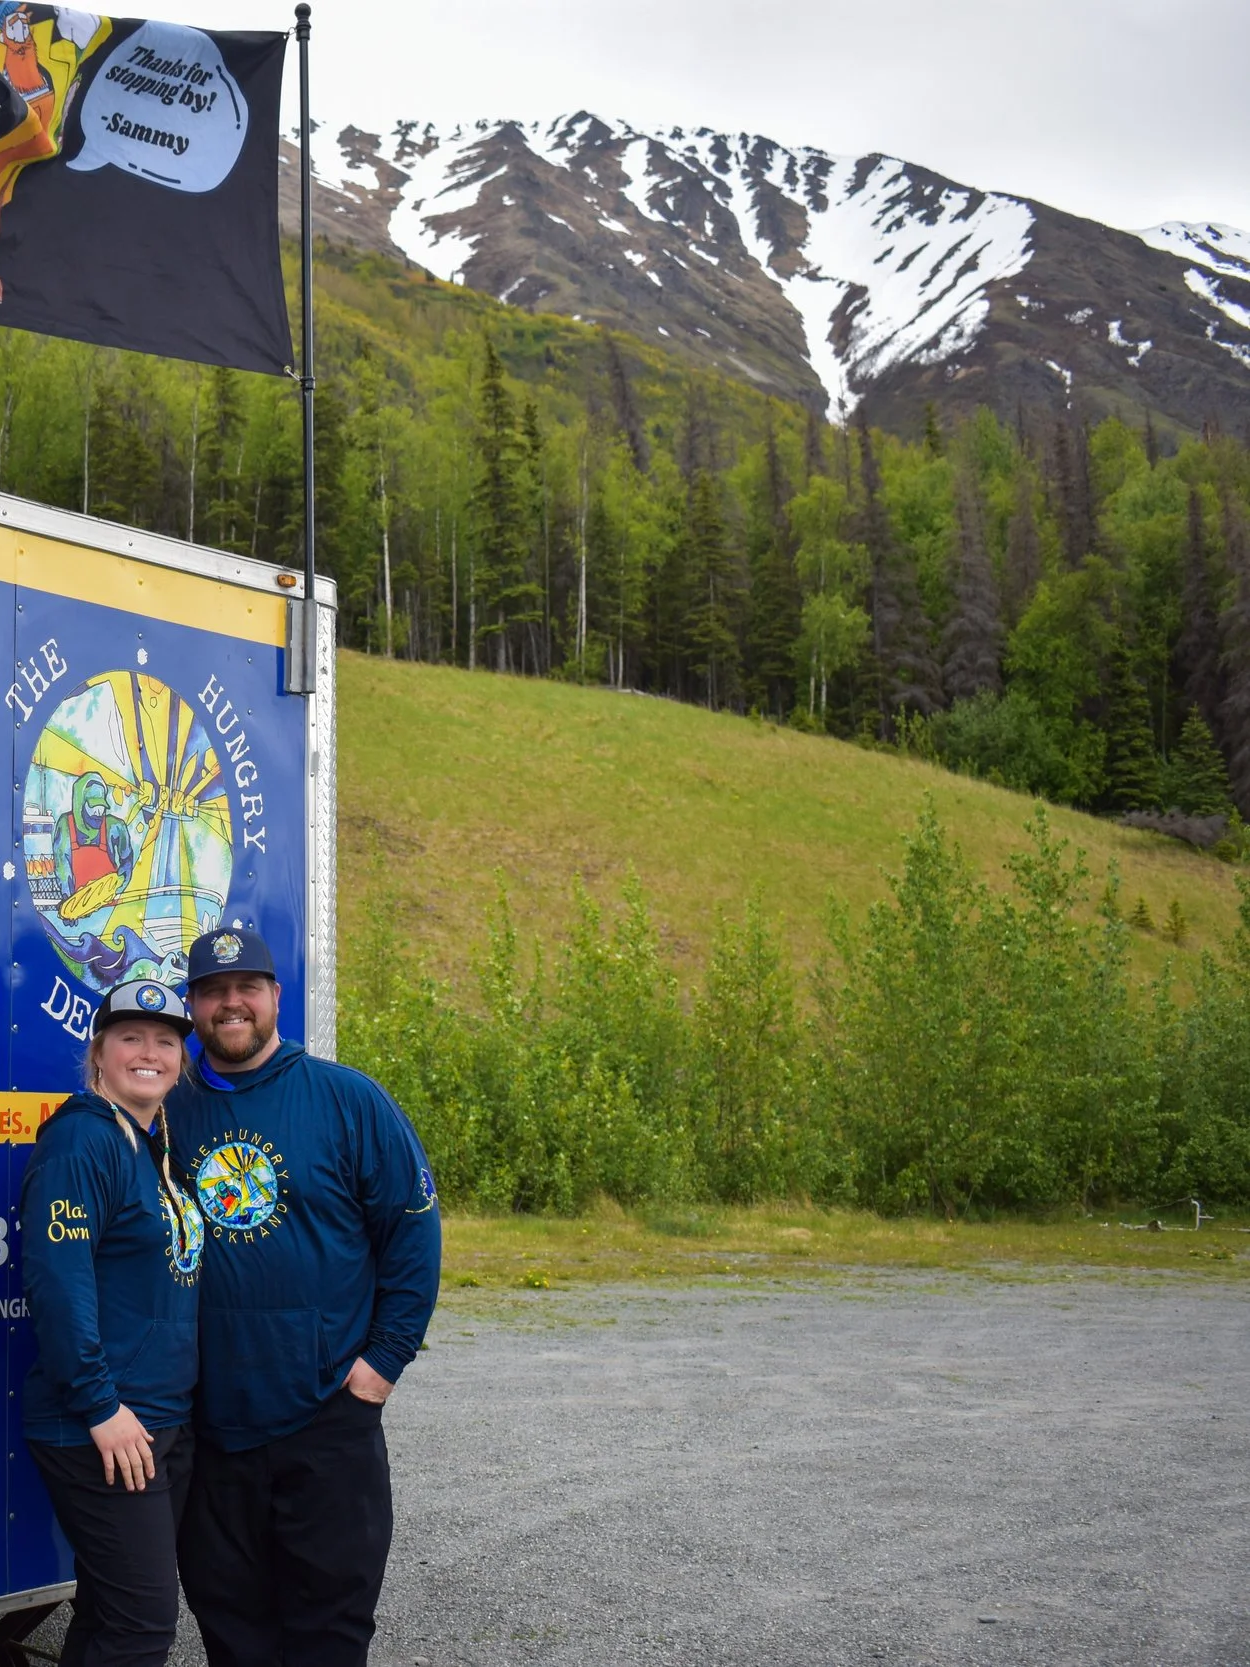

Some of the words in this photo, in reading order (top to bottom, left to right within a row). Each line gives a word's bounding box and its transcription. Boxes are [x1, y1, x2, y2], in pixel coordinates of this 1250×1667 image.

[127, 46, 187, 78] Thanks
[183, 62, 213, 86] for
[106, 65, 183, 105] stopping
[179, 84, 217, 113] by!
[101, 112, 189, 155] -Sammy
[4, 638, 68, 722] THE
[198, 674, 266, 854] HUNGRY
[187, 1145, 210, 1180] THE
[224, 1128, 289, 1180] HUNGRY
[47, 1221, 90, 1242] Own
[50, 1199, 88, 1221] Pla
